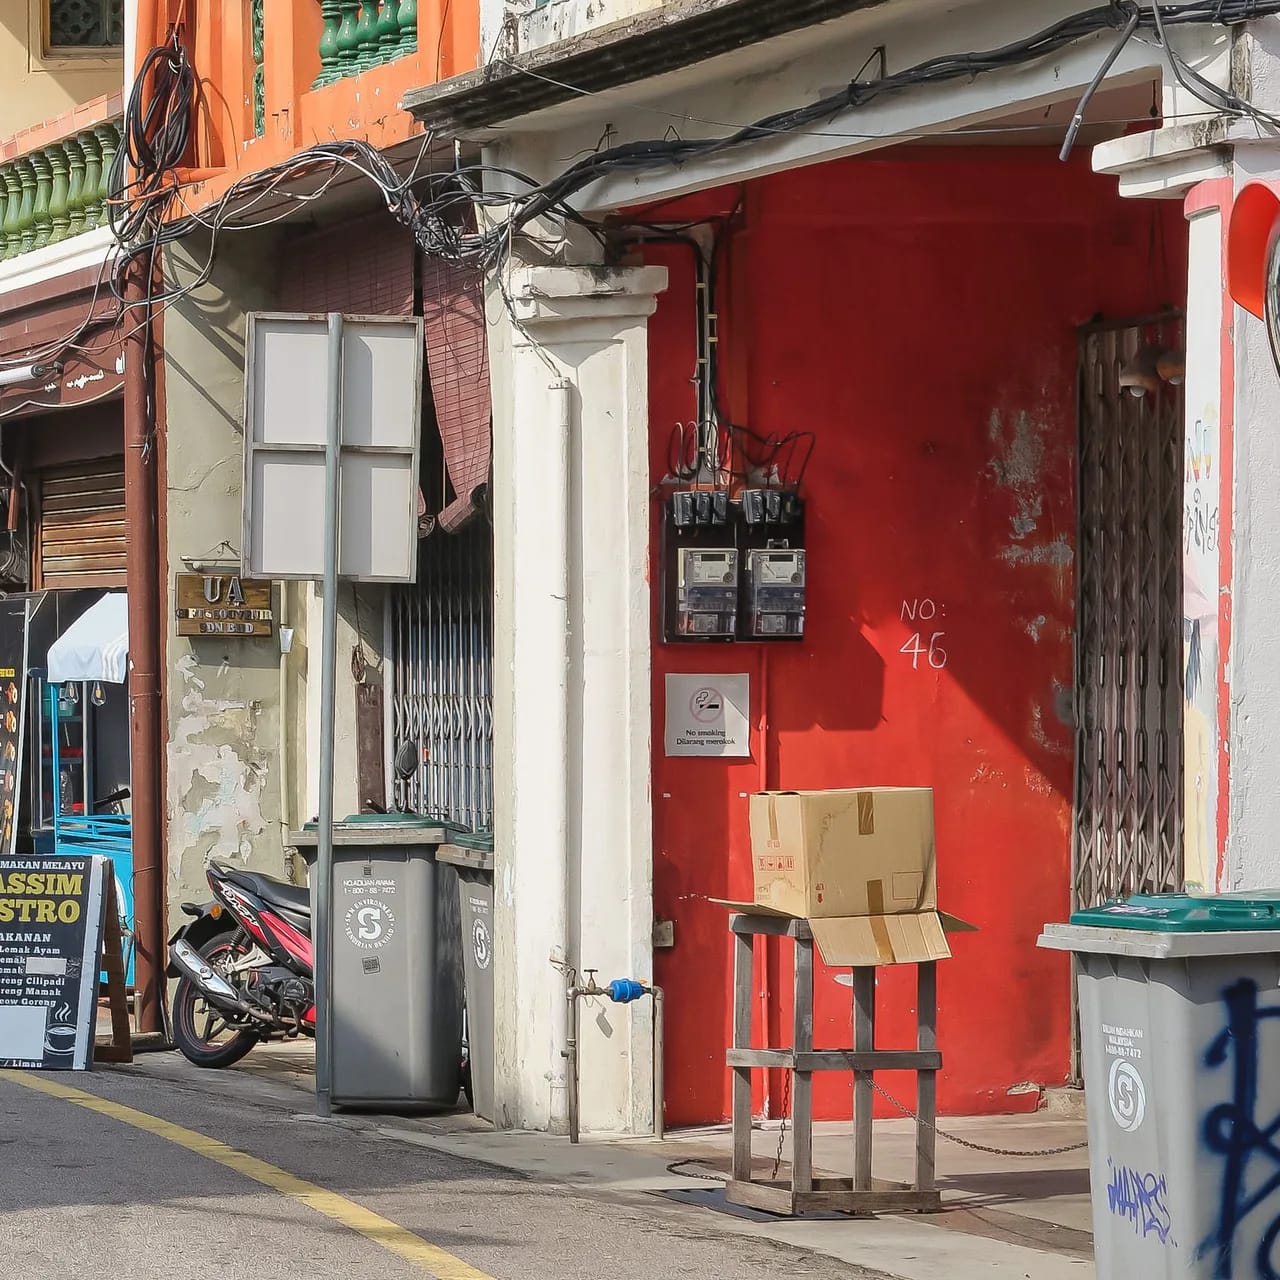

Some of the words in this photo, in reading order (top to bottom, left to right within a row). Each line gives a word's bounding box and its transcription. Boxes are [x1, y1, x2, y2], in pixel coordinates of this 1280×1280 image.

[202, 575, 245, 603] UA
[900, 598, 946, 621] NO:
[900, 631, 947, 671] 46
[697, 729, 726, 737] smoking
[0, 860, 41, 869] MAKAN
[42, 861, 85, 870] MELAYU
[34, 946, 61, 955] Ayam
[26, 977, 65, 987] Cilipadi
[25, 987, 61, 996] Mamak
[21, 997, 56, 1008] Goreng
[13, 1059, 42, 1068] Limau
